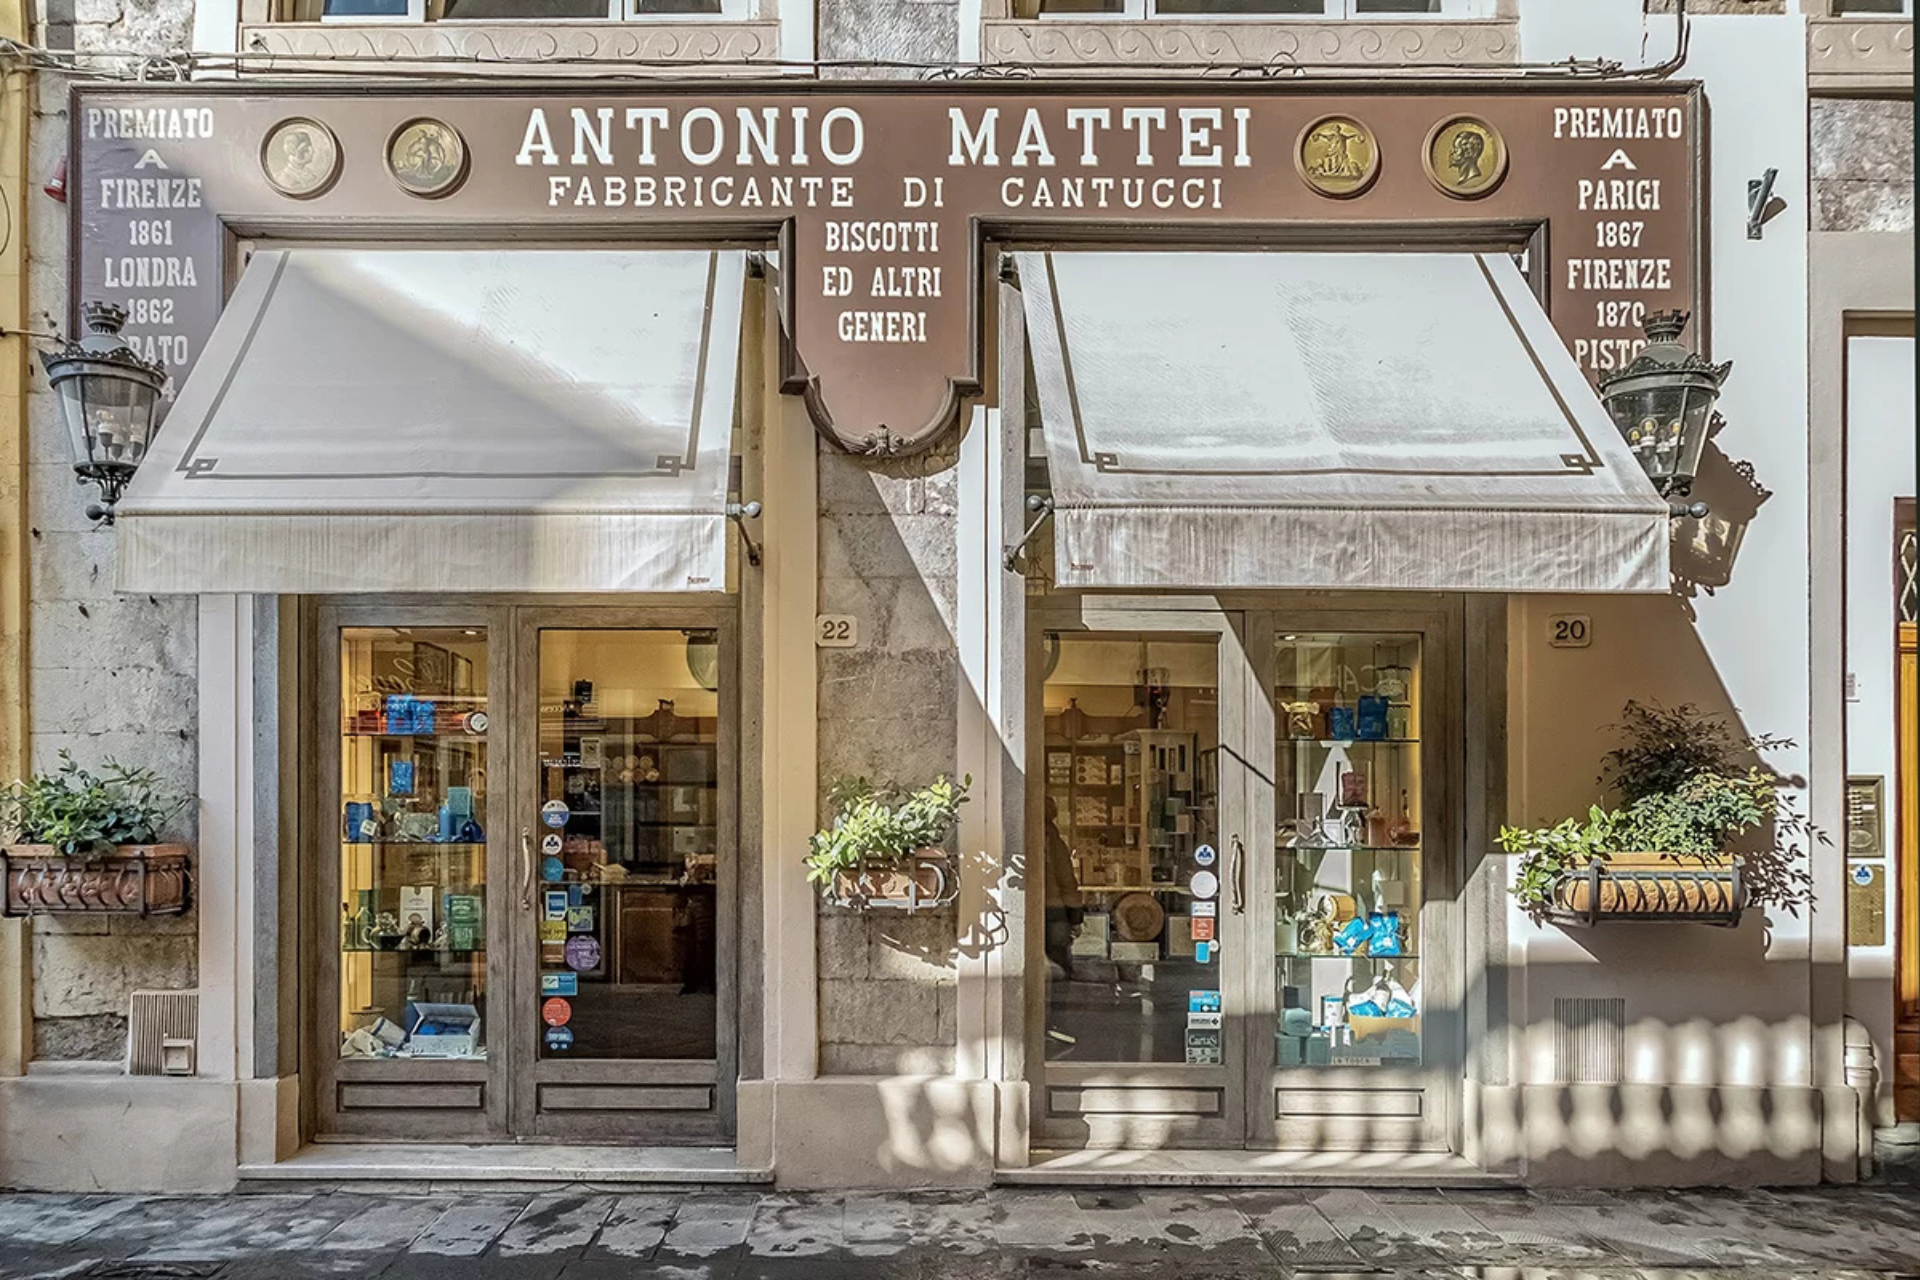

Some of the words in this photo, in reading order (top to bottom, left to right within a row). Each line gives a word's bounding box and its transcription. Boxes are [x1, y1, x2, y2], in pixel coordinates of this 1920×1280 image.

[89, 107, 214, 139] PREMIATO
[515, 107, 864, 166] ANTONIO
[948, 107, 1251, 167] MATTEI
[1553, 107, 1682, 139] PREMIATO
[134, 148, 169, 169] A
[1601, 148, 1637, 170] A
[100, 178, 202, 209] FIRENZE
[548, 176, 853, 207] FABBRICANTE
[903, 177, 944, 207] DI
[1001, 177, 1222, 209] CANTUCCI
[1578, 179, 1660, 210] PARIGI
[129, 219, 173, 246] 1861
[825, 221, 939, 252] BISCOTTI
[1596, 221, 1644, 248] 1867
[104, 256, 197, 288] LONDRA
[822, 266, 853, 297] ED
[870, 266, 941, 297] ALTRI
[1567, 258, 1671, 290] FIRENZE
[126, 298, 174, 324] 1862
[838, 311, 926, 342] GENERI
[1596, 301, 1645, 327] 1870
[127, 335, 188, 366] RATO
[822, 620, 850, 640] 22
[1555, 620, 1586, 640] 20
